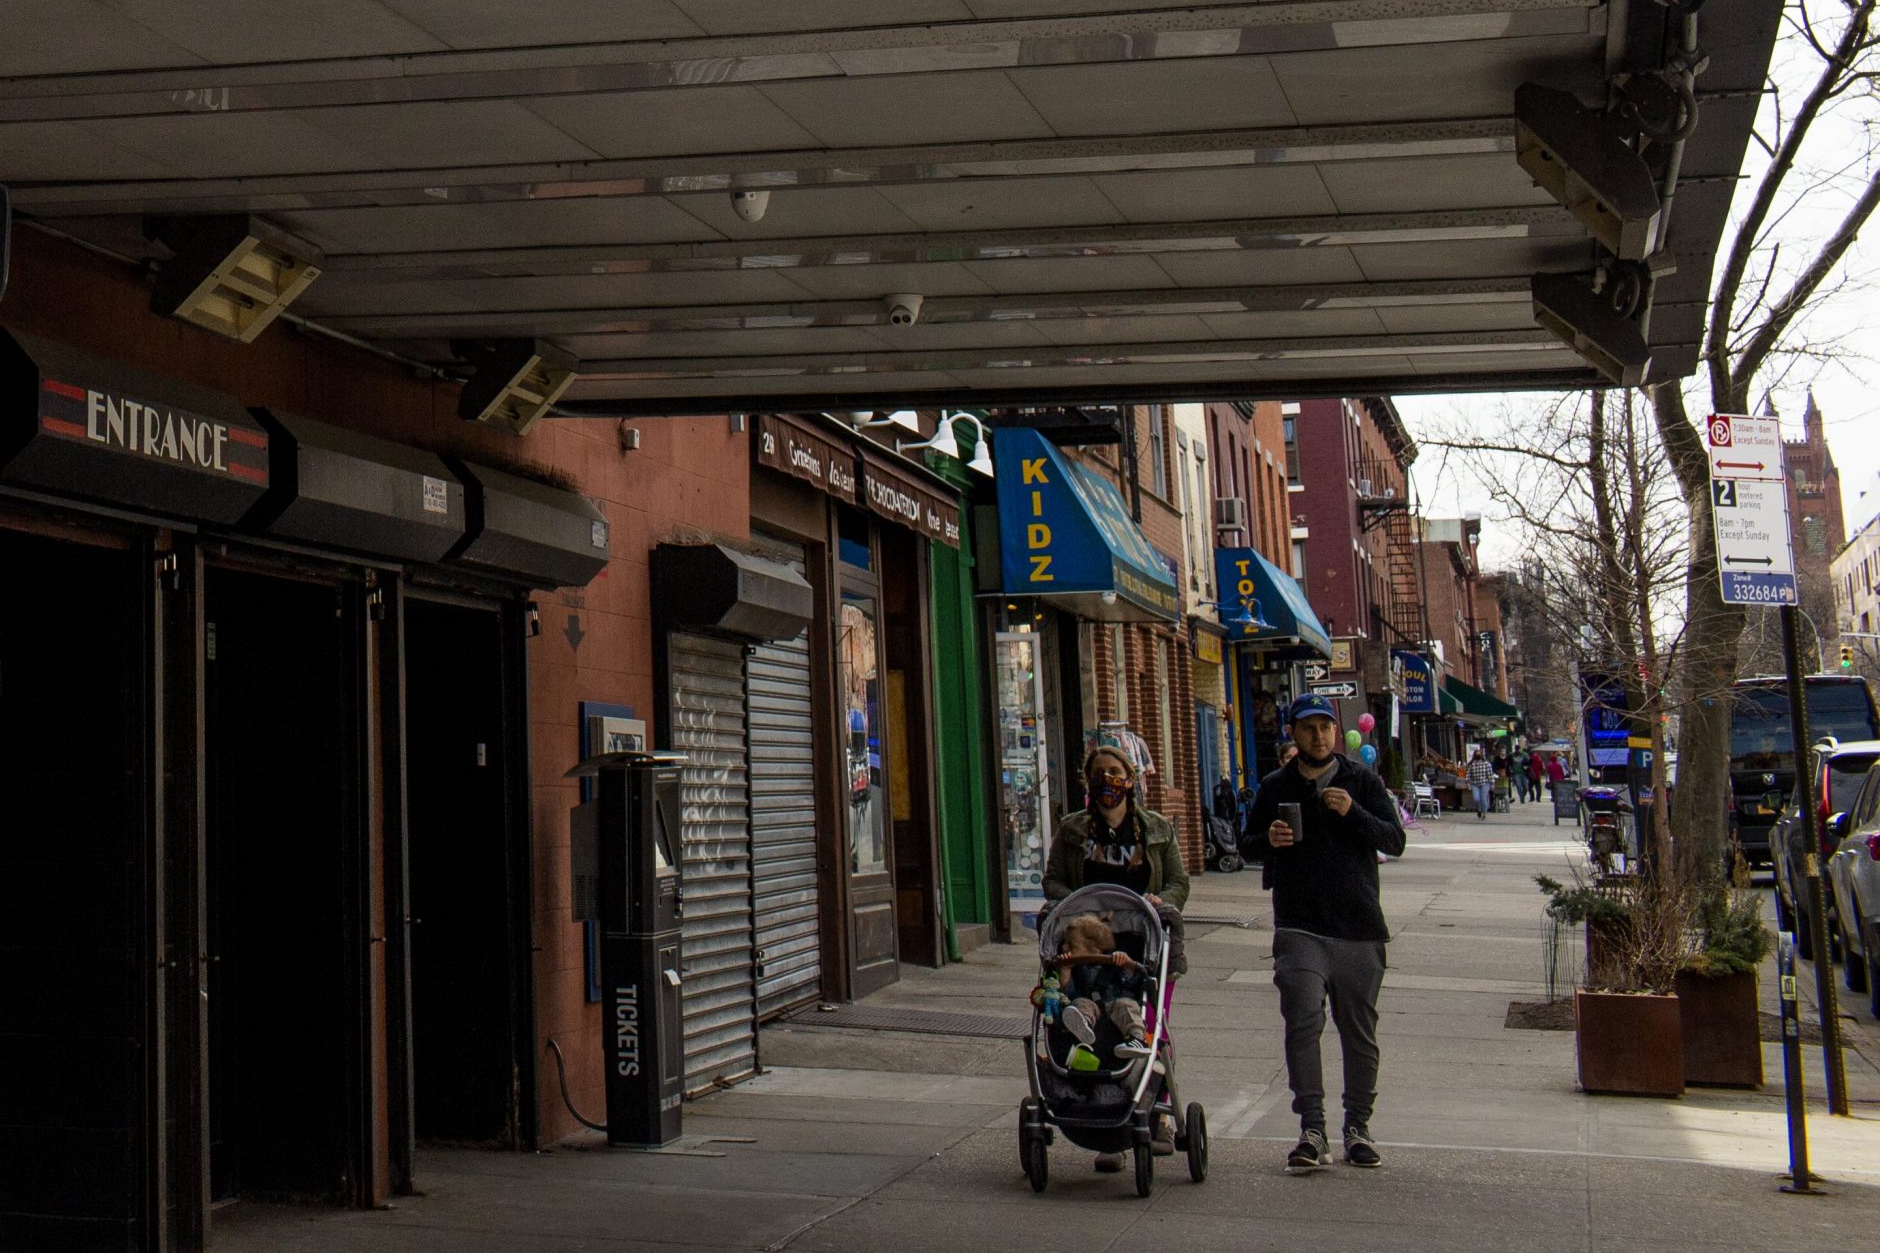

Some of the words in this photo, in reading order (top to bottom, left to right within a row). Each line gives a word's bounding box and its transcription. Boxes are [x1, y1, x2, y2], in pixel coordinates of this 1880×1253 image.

[88, 390, 227, 471] ENTRANCE
[1734, 436, 1754, 445] Except
[1755, 436, 1775, 446] Sunday
[1718, 481, 1731, 505] 2
[1740, 501, 1761, 510] parking
[1022, 458, 1053, 581] KIDZ
[1720, 518, 1734, 527] 8am
[1741, 519, 1755, 529] 7pm
[1721, 531, 1744, 541] Except
[1746, 531, 1770, 541] Sunday
[1734, 584, 1778, 601] 332684
[617, 985, 638, 1075] TICKETS
